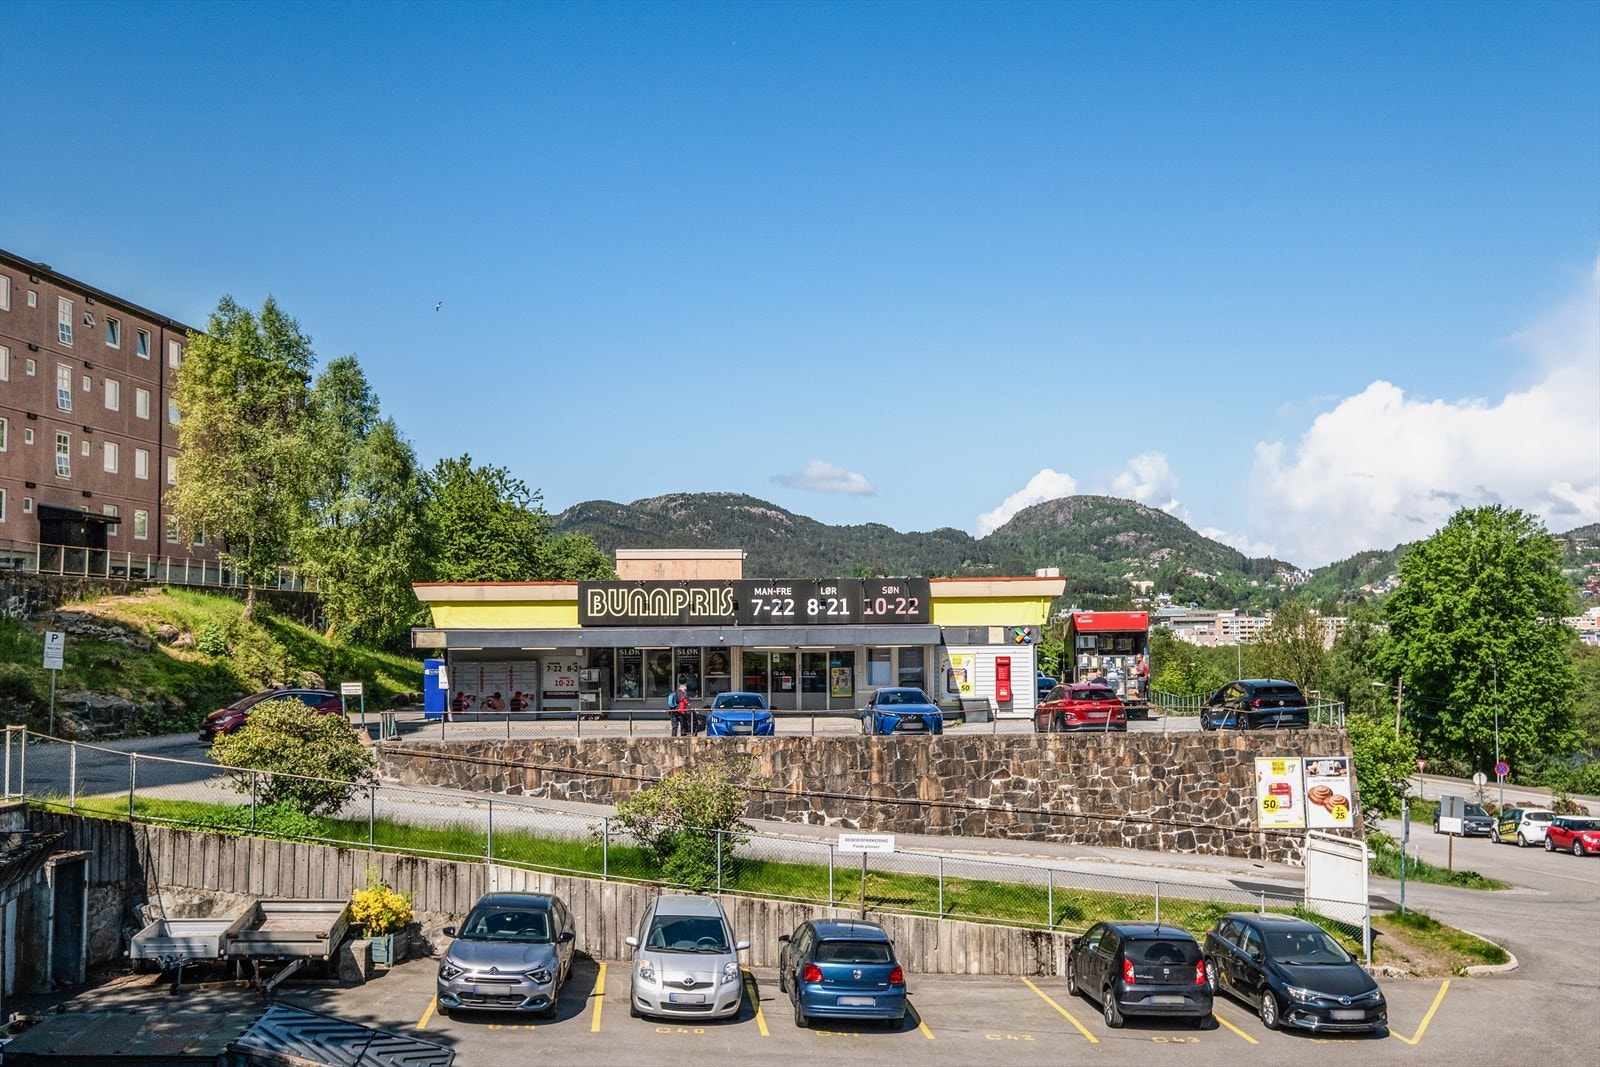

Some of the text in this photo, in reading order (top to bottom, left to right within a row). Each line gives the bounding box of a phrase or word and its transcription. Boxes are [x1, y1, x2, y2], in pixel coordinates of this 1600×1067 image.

[754, 586, 900, 596] MAN-FRE LØR SØN
[751, 597, 919, 616] 7-22 8-21 10-22
[51, 633, 59, 643] P
[546, 665, 563, 673] 7-22
[554, 679, 575, 687] 10-22
[1335, 812, 1345, 820] 25
